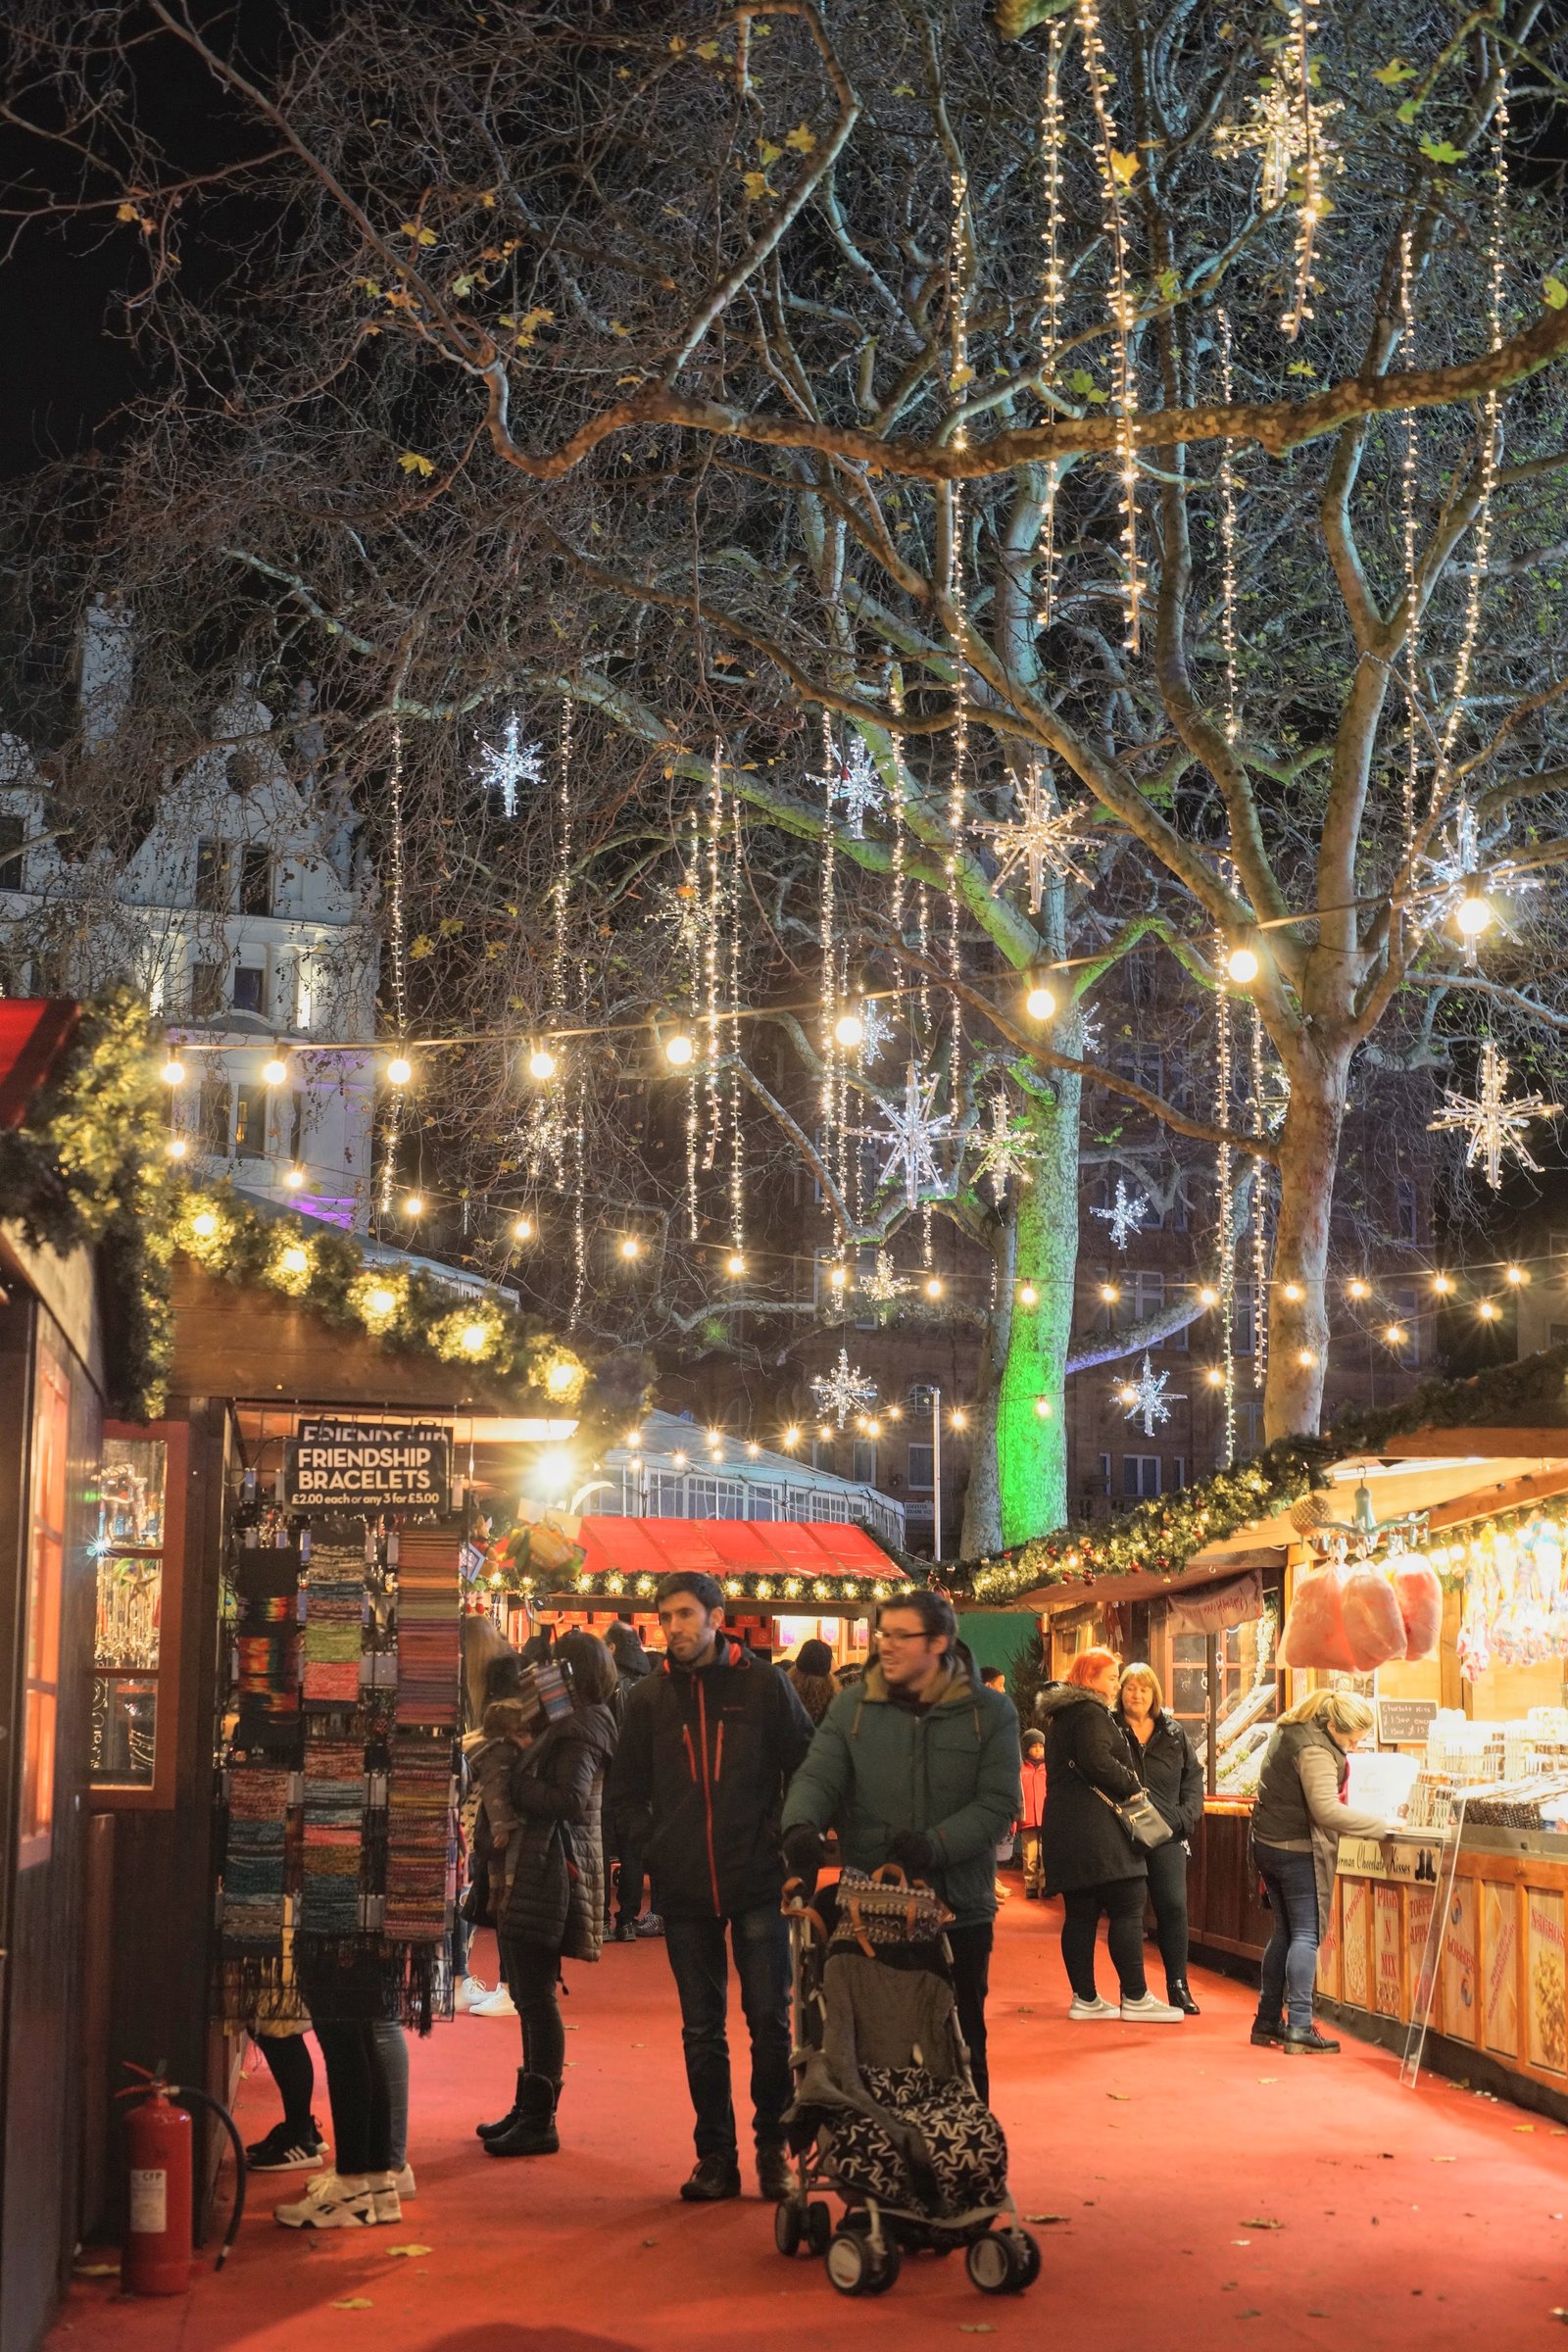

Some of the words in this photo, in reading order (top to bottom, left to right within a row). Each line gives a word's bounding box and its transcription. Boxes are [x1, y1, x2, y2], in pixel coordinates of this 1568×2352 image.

[298, 1447, 431, 1468] FRIENDSHIP
[298, 1470, 431, 1490] BRACELETS
[291, 1494, 323, 1505] £2.00
[324, 1493, 350, 1504] each
[351, 1494, 362, 1504] or
[363, 1494, 382, 1506] any
[383, 1493, 391, 1504] 3
[392, 1493, 408, 1504] for
[408, 1493, 440, 1504] £5.00
[1337, 1857, 1355, 1867] erman
[1356, 1841, 1385, 1872] Chocolate
[1388, 1846, 1411, 1874] Kisses
[1409, 1922, 1431, 1944] APPL
[1381, 1952, 1396, 1979] MIX
